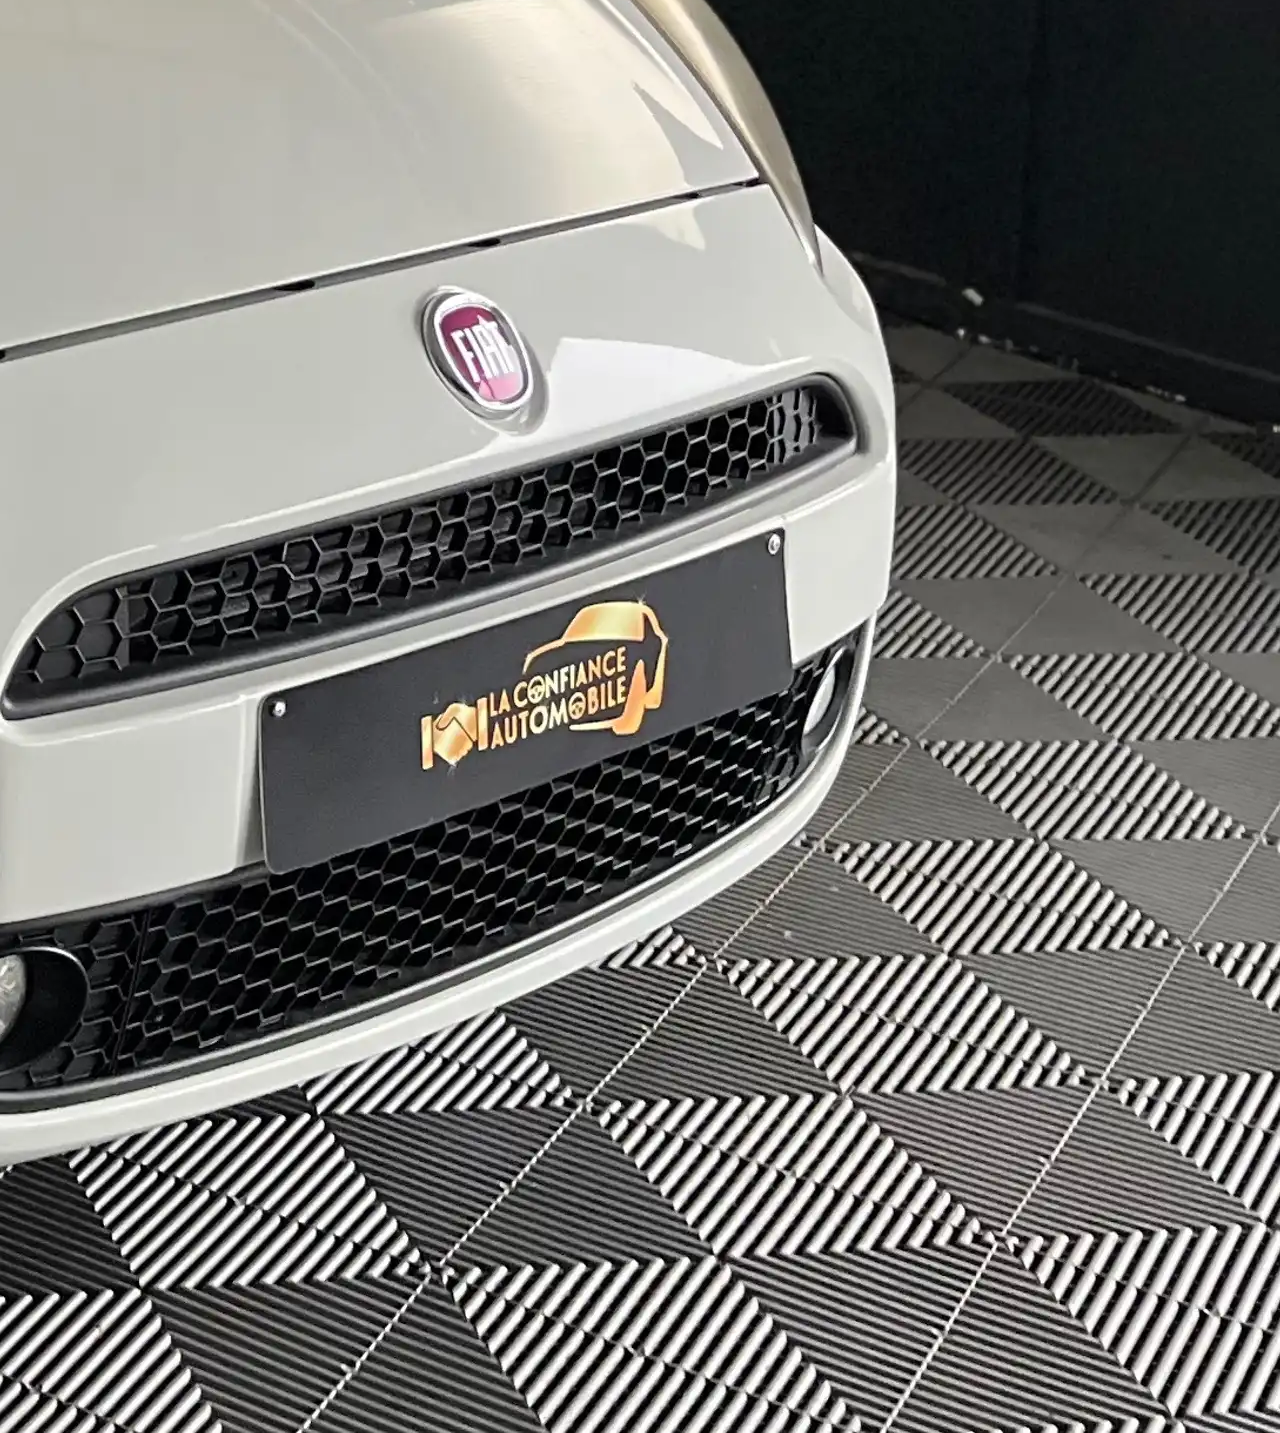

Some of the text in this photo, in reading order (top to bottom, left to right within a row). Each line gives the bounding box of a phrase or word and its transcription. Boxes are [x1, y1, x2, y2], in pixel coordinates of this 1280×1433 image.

[450, 317, 514, 383] FIAT
[489, 646, 627, 717] LA CONFIANCE
[490, 675, 627, 750] AUTOMOBILE
